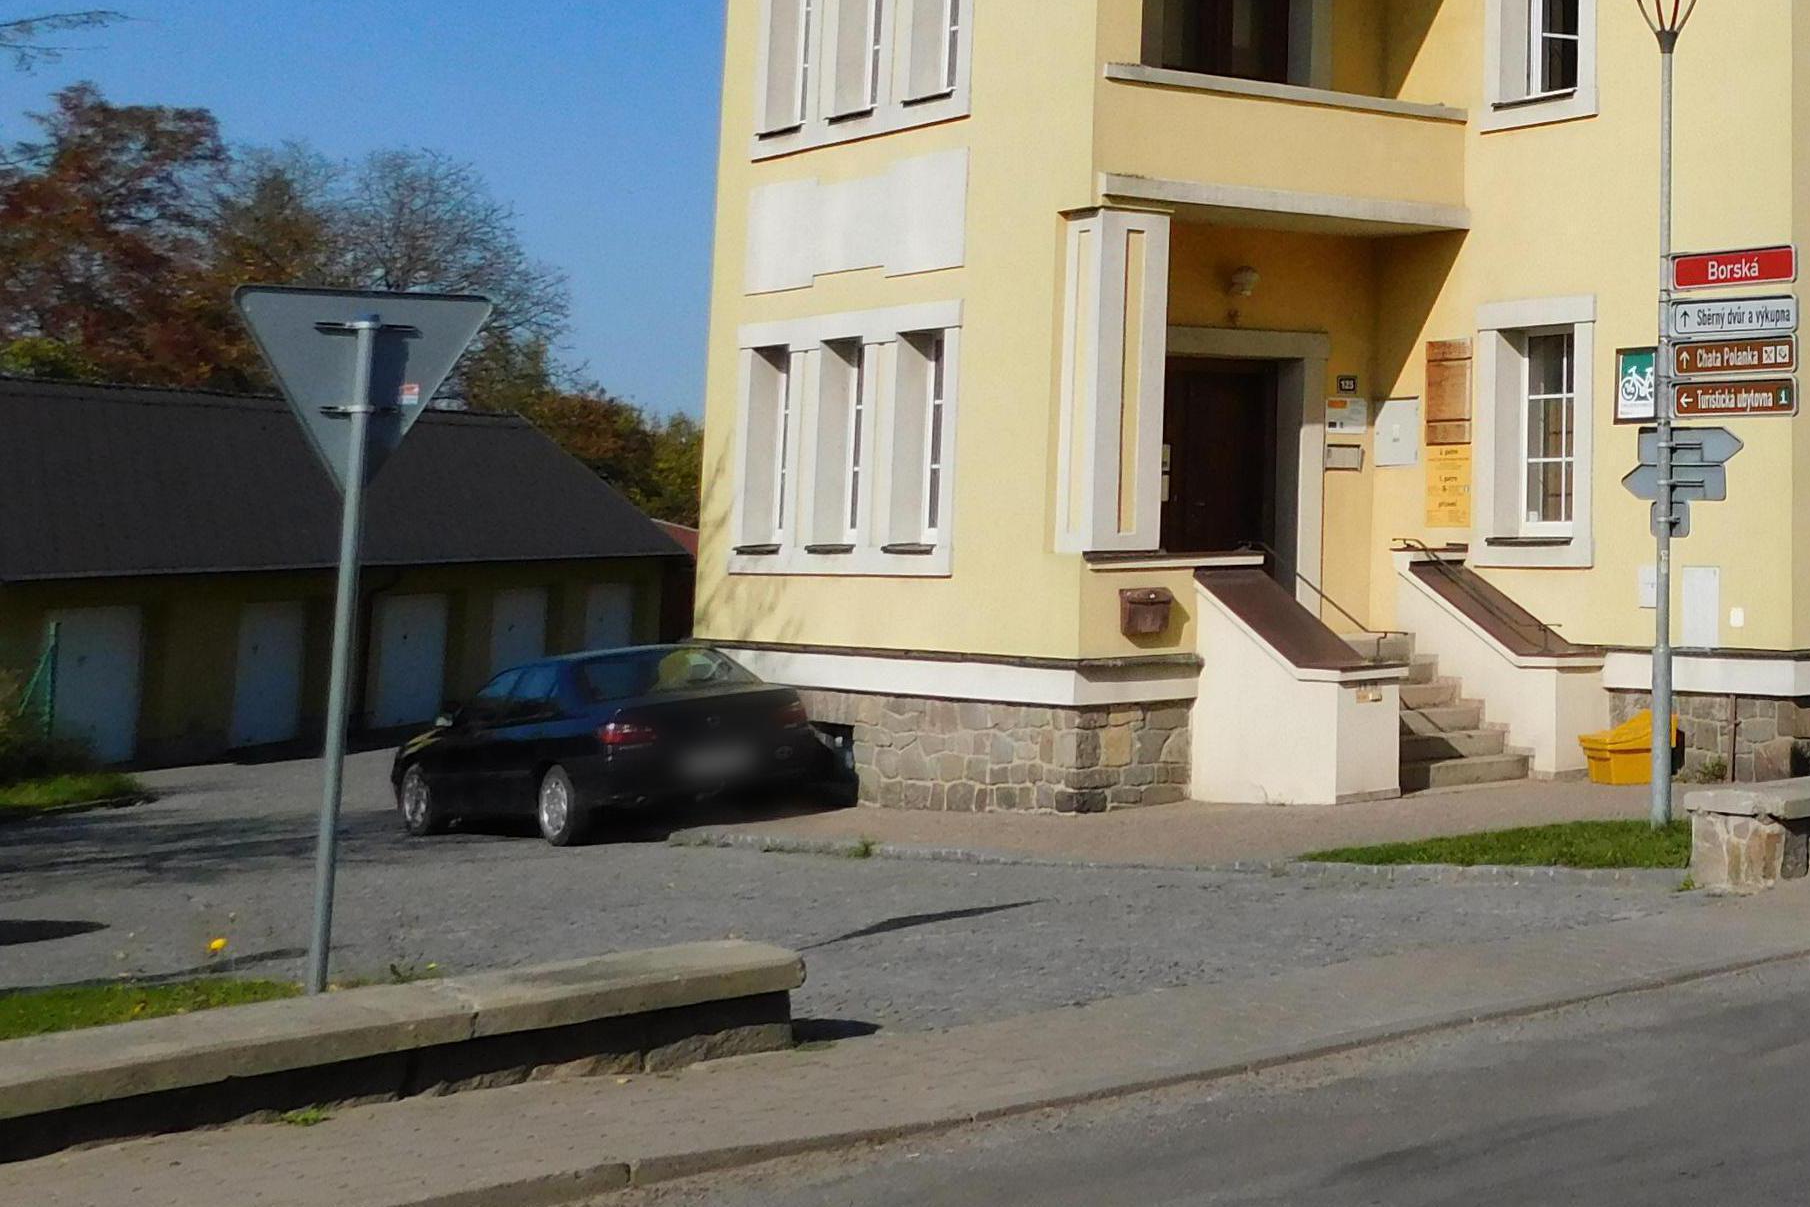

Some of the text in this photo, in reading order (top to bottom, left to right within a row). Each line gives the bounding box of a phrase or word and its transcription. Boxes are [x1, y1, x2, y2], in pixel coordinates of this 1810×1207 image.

[1707, 257, 1759, 281] Borská
[1696, 306, 1790, 329] Sběrný dvůr a výkupna
[1696, 346, 1758, 367] Chata Polanka
[1697, 388, 1773, 412] Turistická ubytovna
